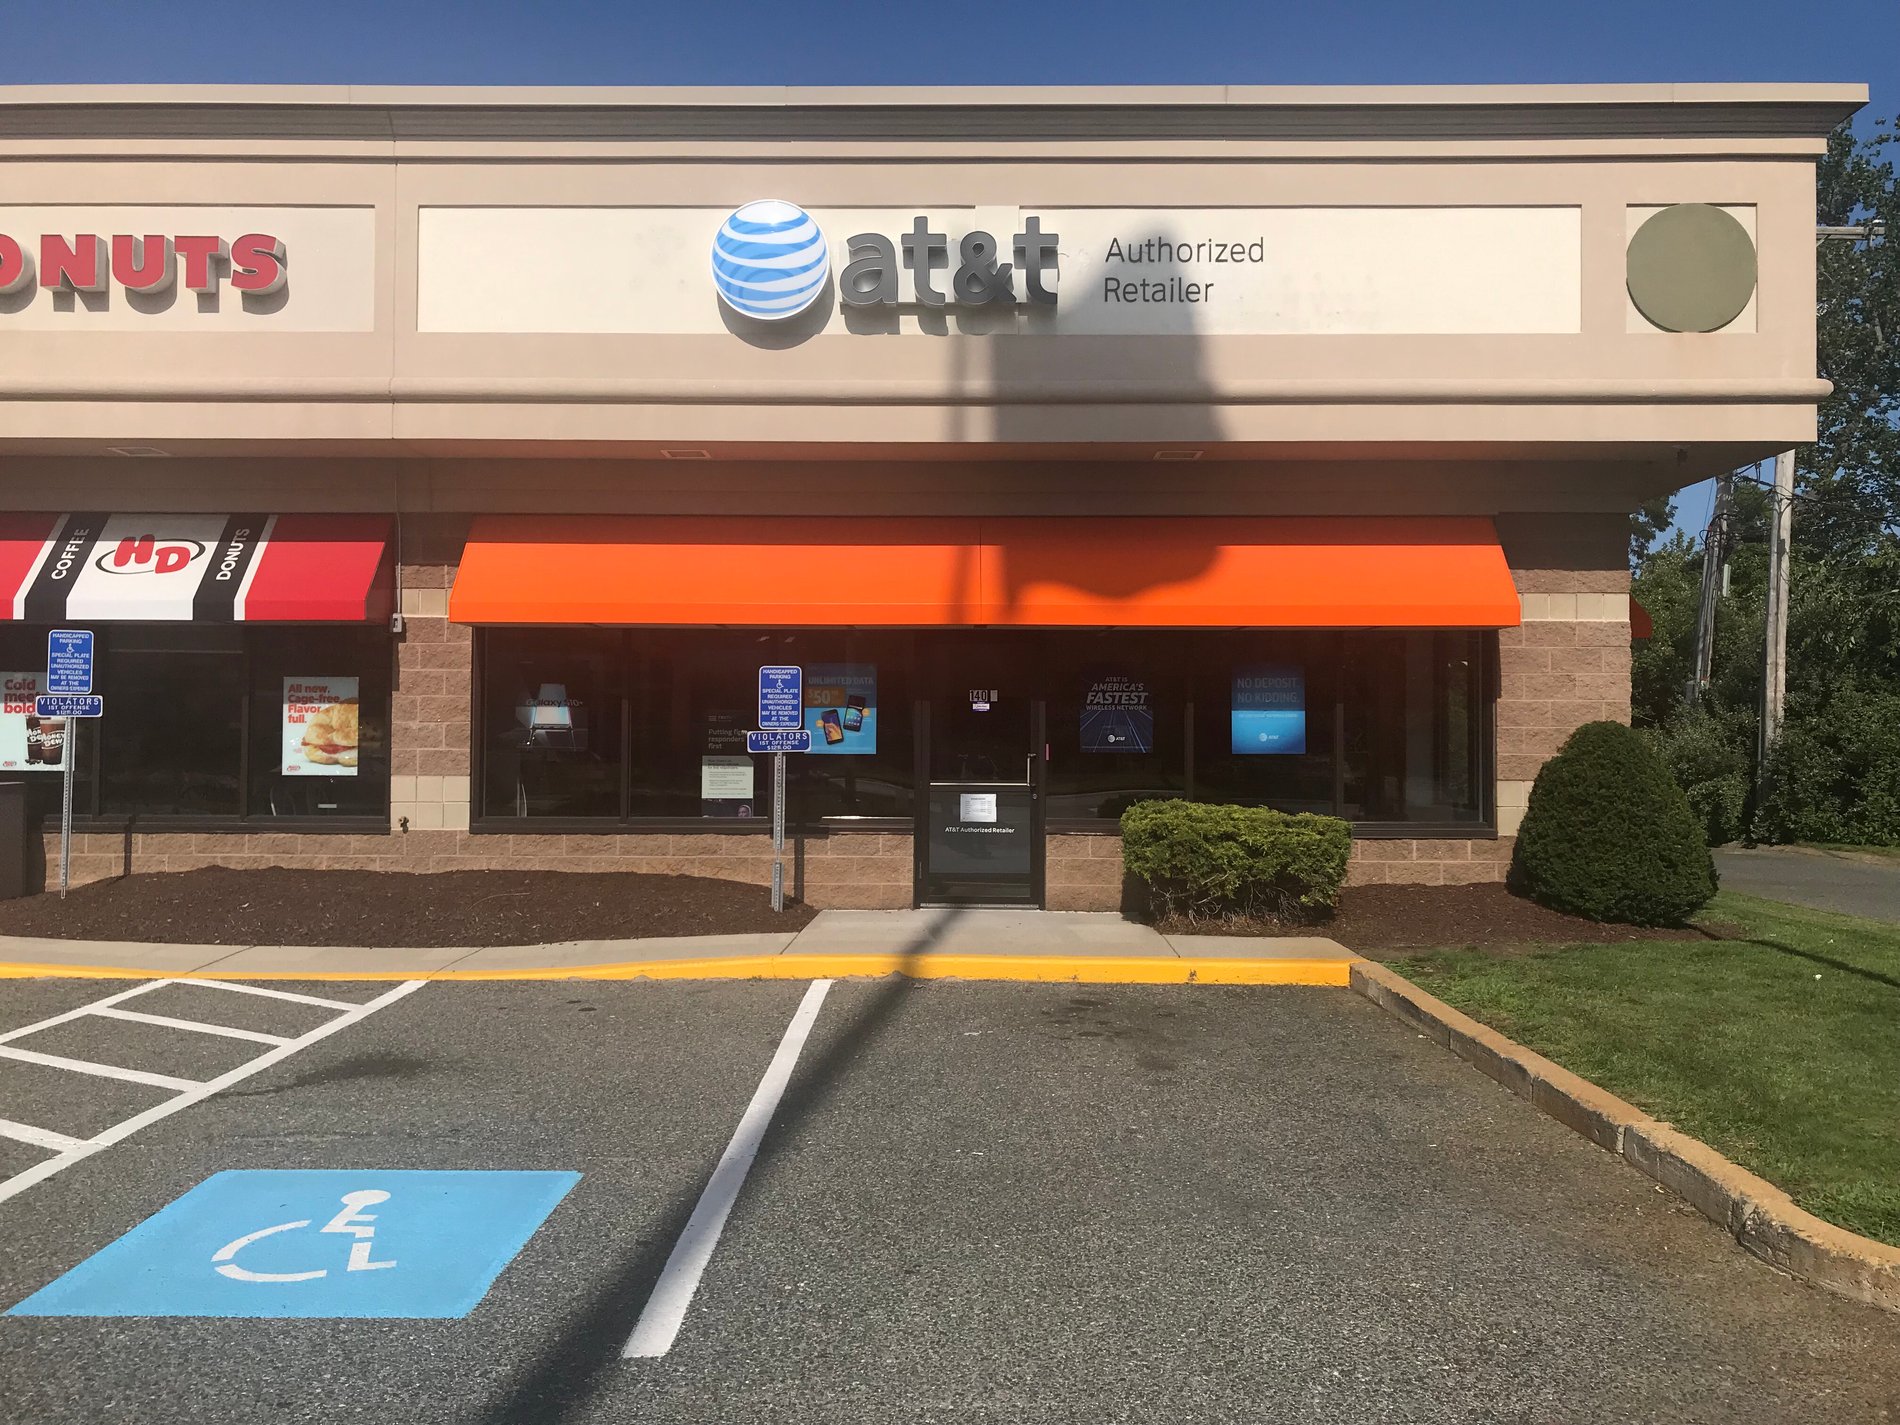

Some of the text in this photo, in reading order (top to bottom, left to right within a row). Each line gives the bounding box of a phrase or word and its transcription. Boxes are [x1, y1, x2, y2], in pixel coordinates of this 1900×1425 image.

[1104, 236, 1264, 264] Authorized
[839, 215, 1059, 306] at&t
[1103, 275, 1215, 304] Retailer
[51, 527, 90, 580] COFFEE
[114, 533, 191, 574] HD
[215, 527, 250, 581] DONUTS
[5, 679, 36, 690] Cold
[808, 676, 874, 685] UNLIMITED DATA
[1237, 677, 1252, 688] NO
[288, 684, 330, 693] All new.
[1091, 683, 1145, 691] AMERICA'S
[288, 694, 341, 704] Cage-free
[970, 690, 987, 701] 140
[1086, 692, 1149, 704] FASTEST
[1237, 691, 1252, 703] NO
[40, 697, 99, 706] VIOLATORS
[526, 698, 562, 708] Galaxy
[288, 704, 322, 714] Flavor
[288, 714, 307, 724] full.
[751, 732, 808, 741] VIOLATORS
